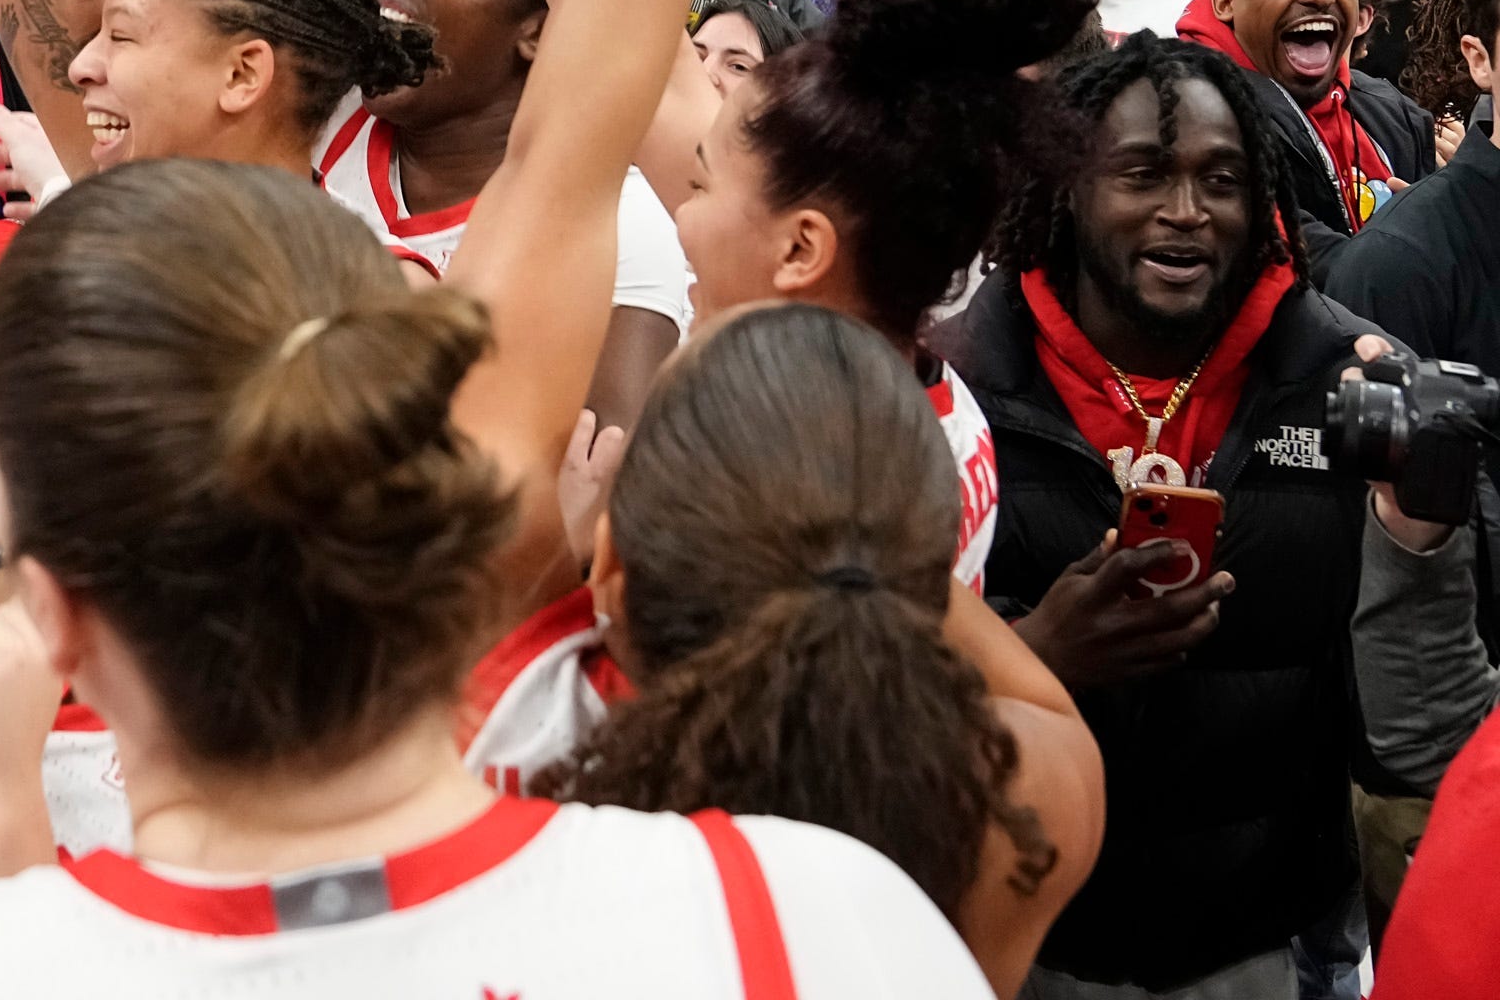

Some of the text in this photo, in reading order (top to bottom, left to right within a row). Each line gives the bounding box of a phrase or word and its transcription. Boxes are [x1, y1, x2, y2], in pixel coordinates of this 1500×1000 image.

[1279, 425, 1314, 442] THE
[1253, 438, 1313, 456] NORTH
[1269, 451, 1313, 468] FACE
